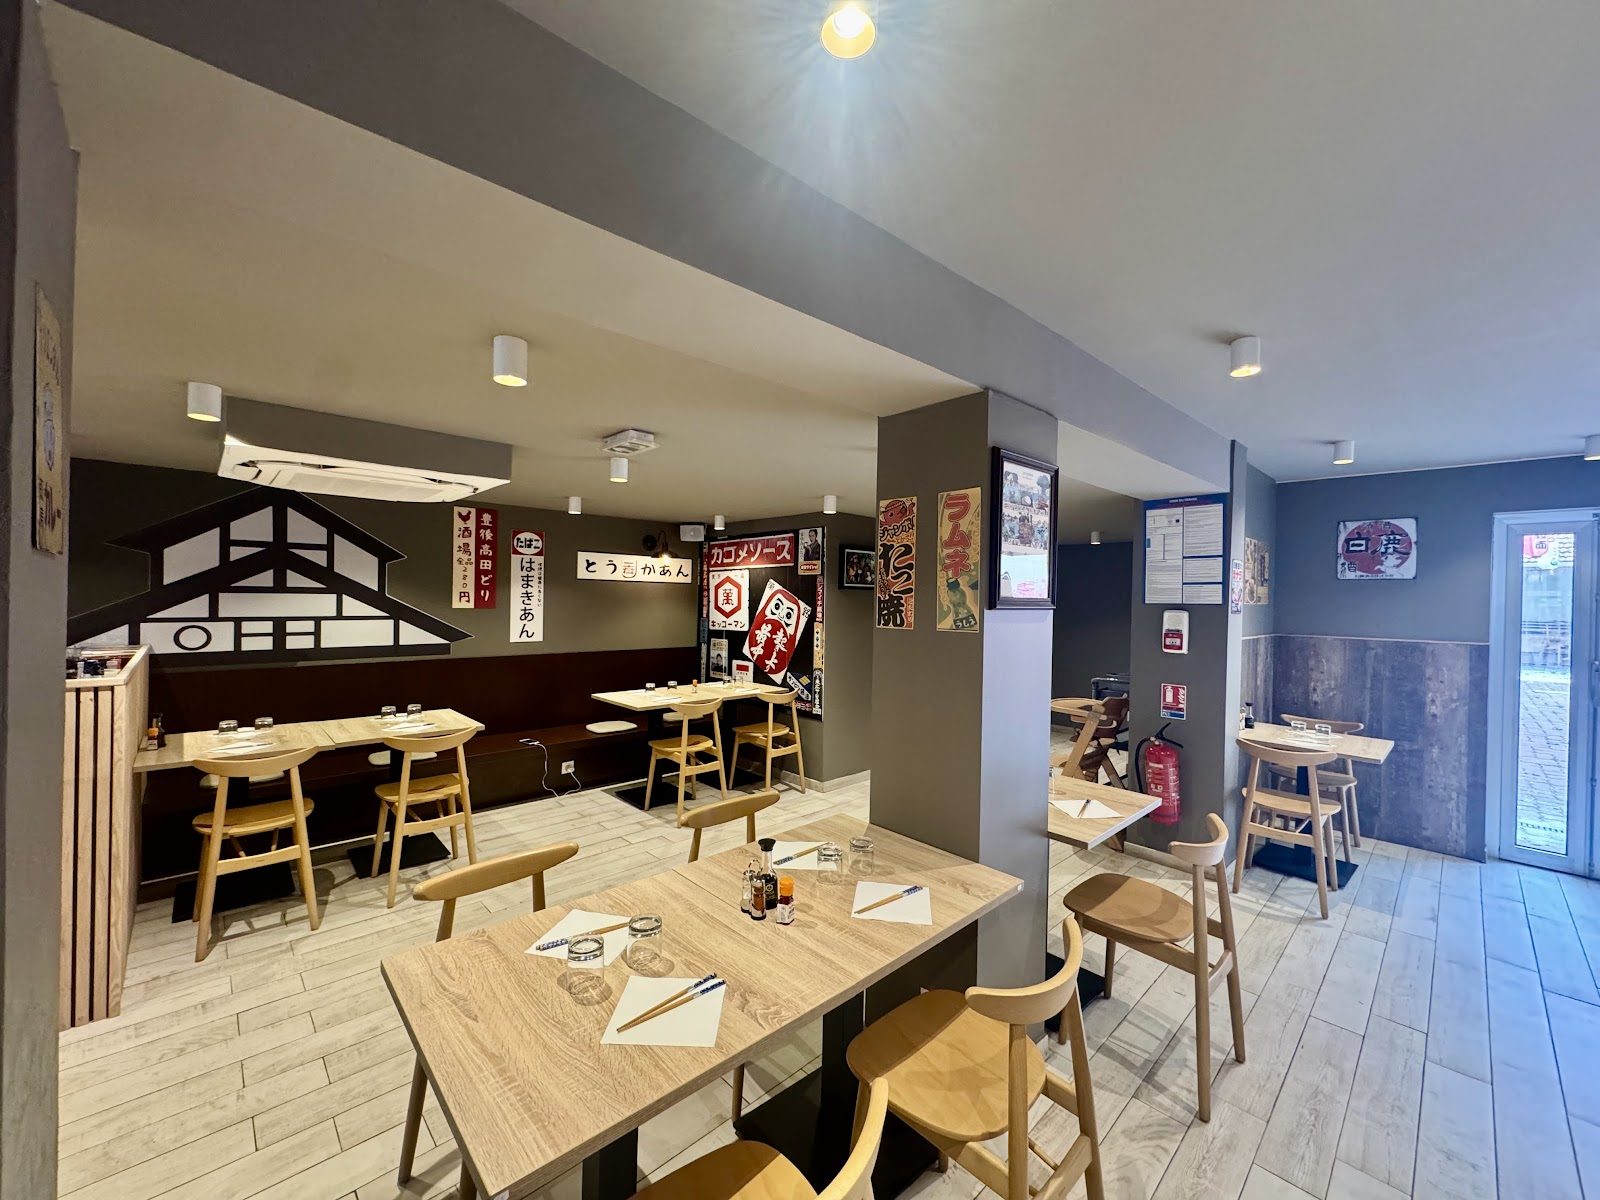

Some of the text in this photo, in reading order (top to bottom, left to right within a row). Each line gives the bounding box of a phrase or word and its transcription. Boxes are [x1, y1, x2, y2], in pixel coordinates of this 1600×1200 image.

[479, 512, 494, 602] 豊後高田どり
[710, 541, 791, 566] カゴメソース
[943, 495, 971, 579] ラムネ
[519, 557, 536, 639] はまきあん
[710, 620, 746, 629] キッコーマン
